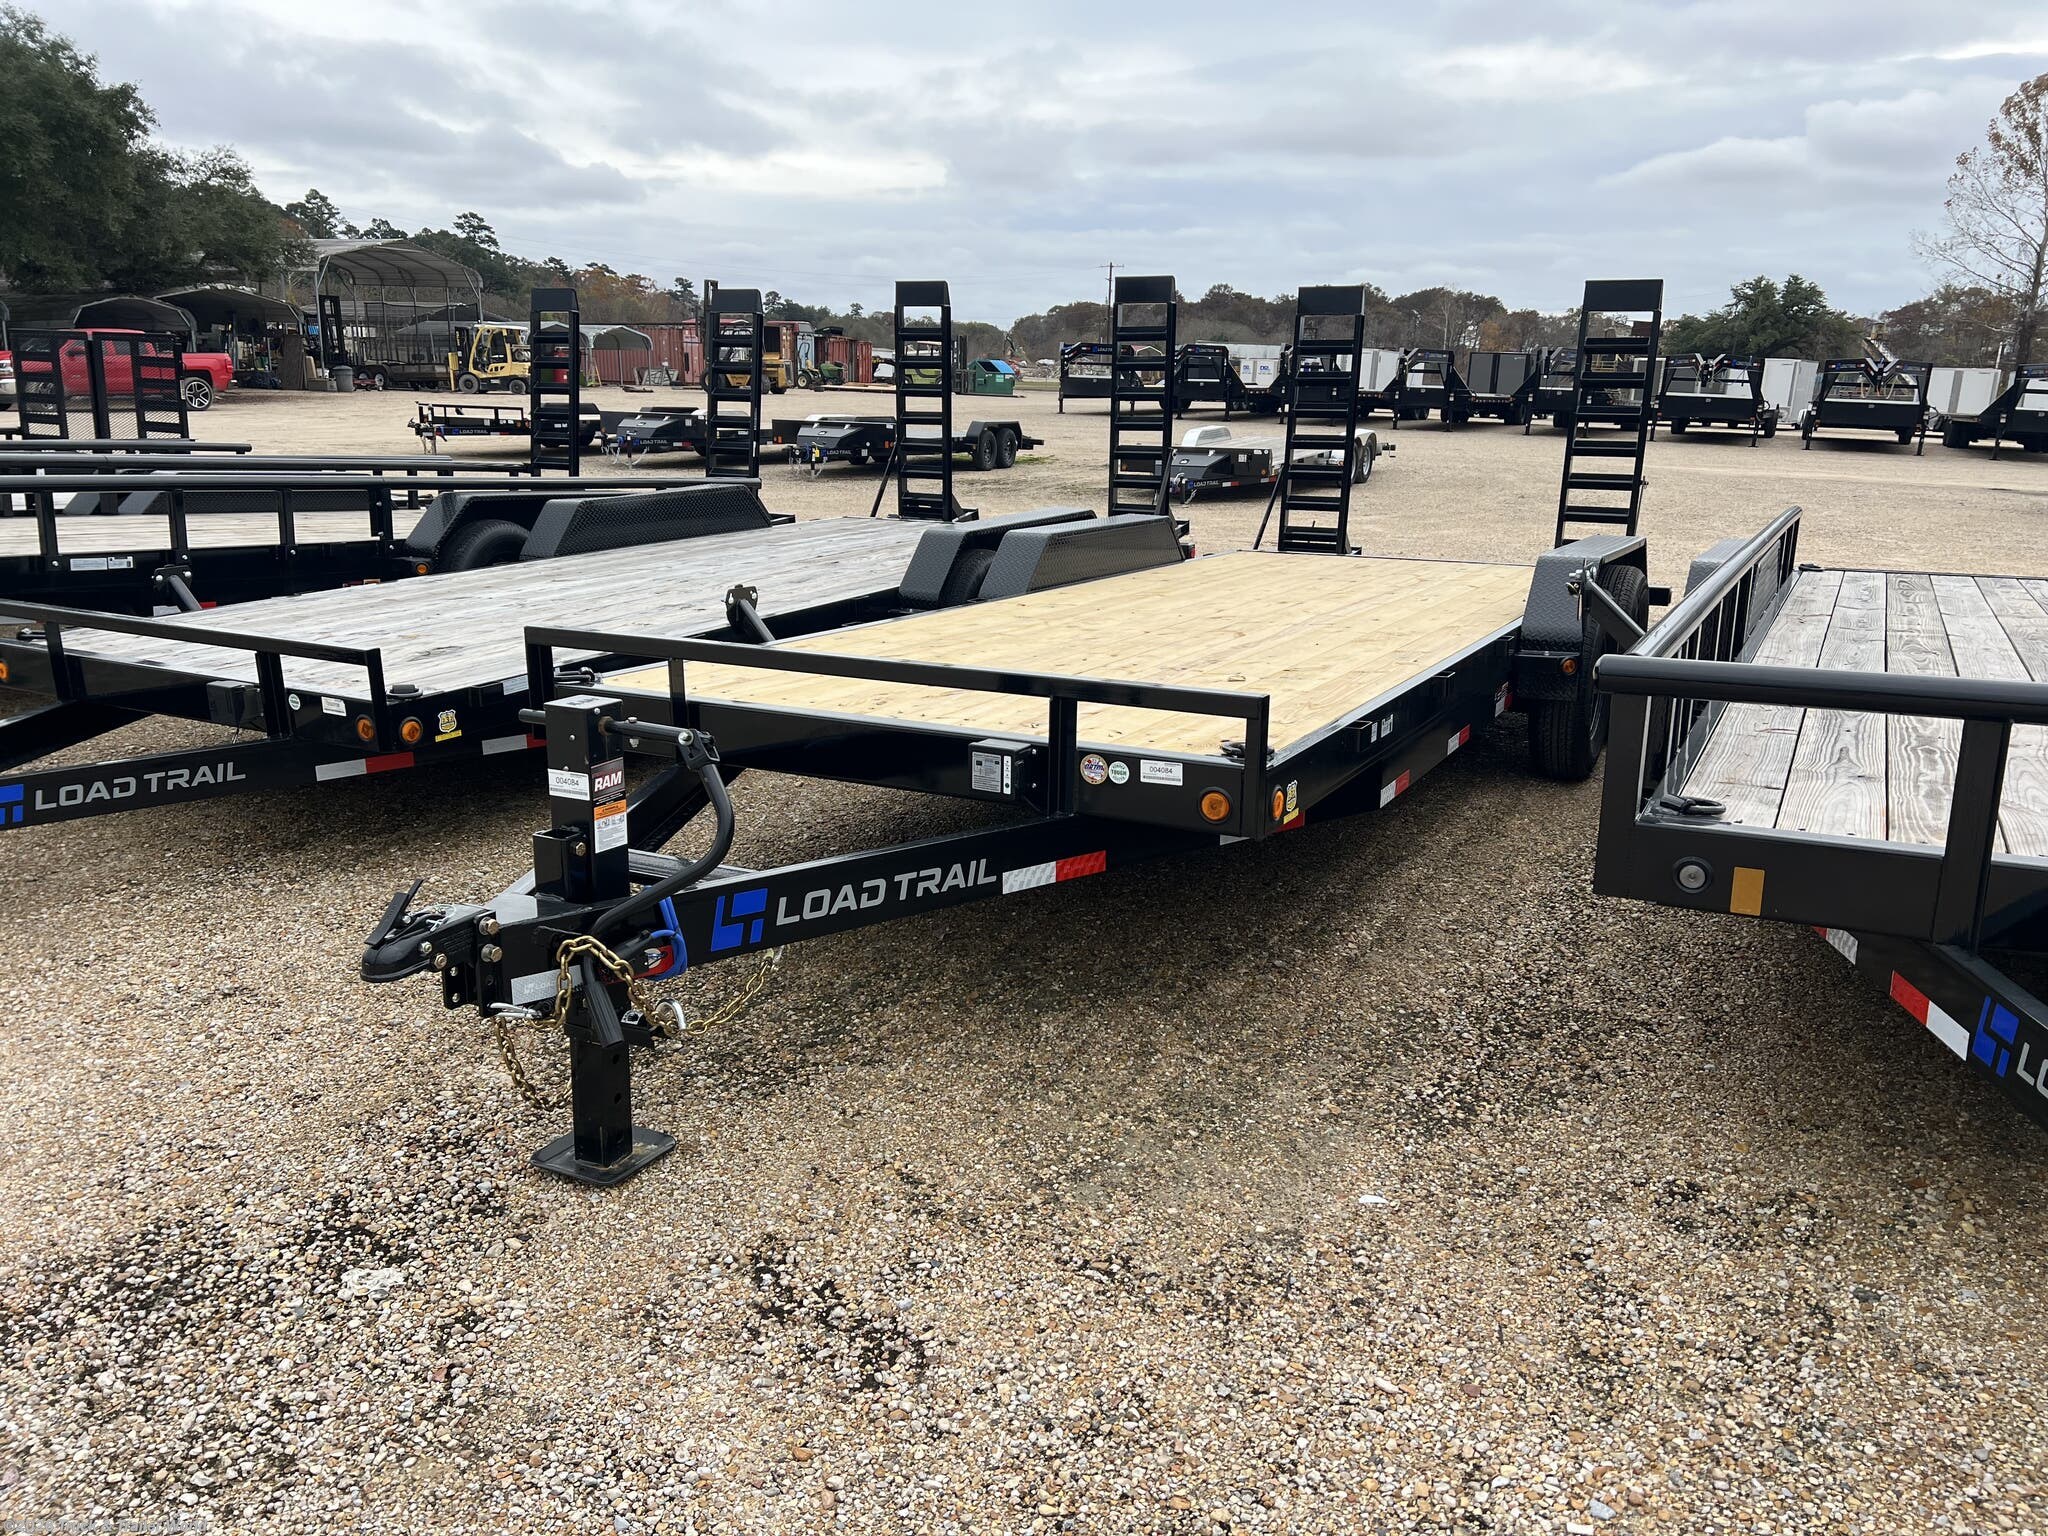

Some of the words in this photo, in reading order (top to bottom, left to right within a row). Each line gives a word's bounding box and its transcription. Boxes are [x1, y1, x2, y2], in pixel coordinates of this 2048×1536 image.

[555, 776, 580, 786] 004084
[594, 770, 622, 792] RAM
[1149, 766, 1173, 774] 004084
[35, 776, 137, 810] LOAD
[143, 762, 246, 793] TRAIL
[775, 878, 887, 926] LOAD
[894, 858, 997, 901] TRAIL
